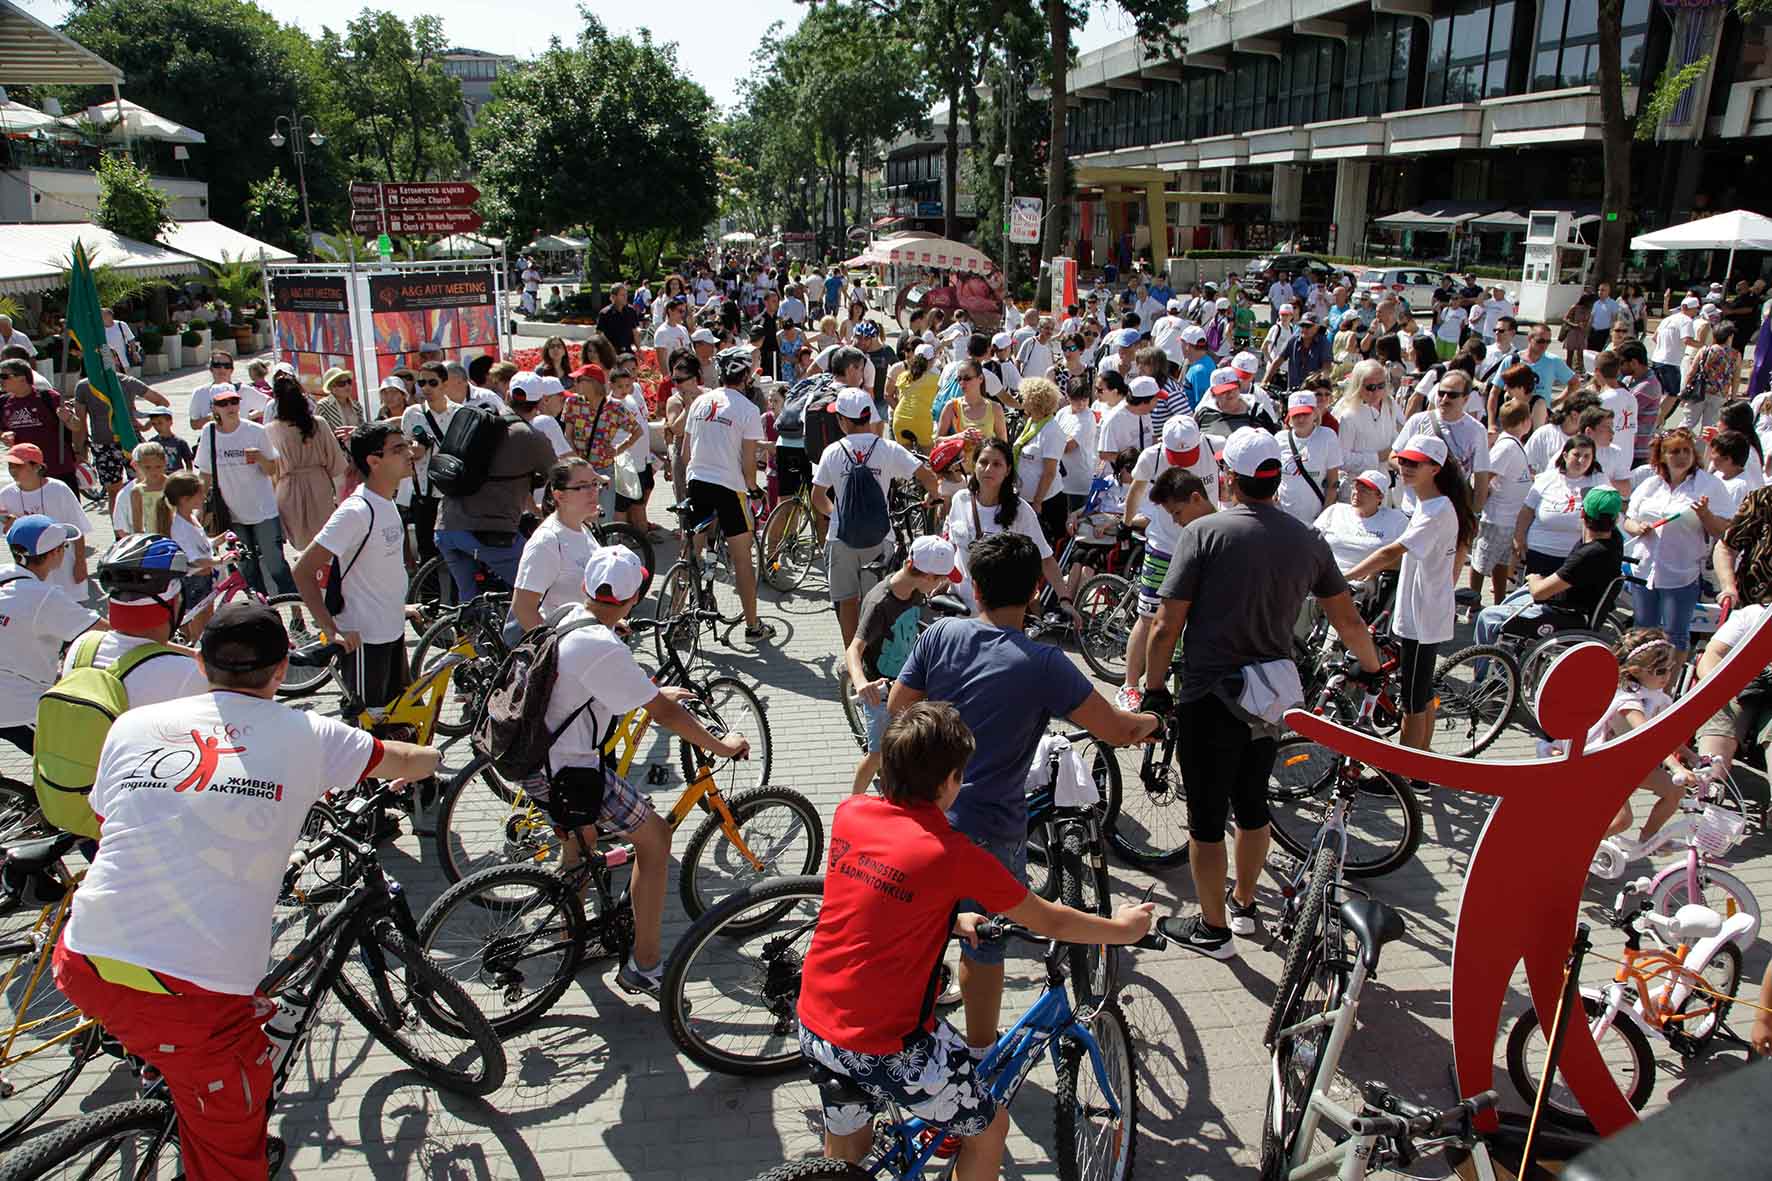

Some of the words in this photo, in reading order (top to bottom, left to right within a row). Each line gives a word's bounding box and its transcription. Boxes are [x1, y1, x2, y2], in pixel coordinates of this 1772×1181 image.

[400, 196, 426, 205] Catholic
[428, 196, 451, 205] Church
[401, 285, 424, 297] A&G
[424, 284, 443, 296] ART
[446, 281, 487, 295] MEETING
[120, 781, 169, 792] години
[228, 776, 275, 791] ЖИВЕЙ
